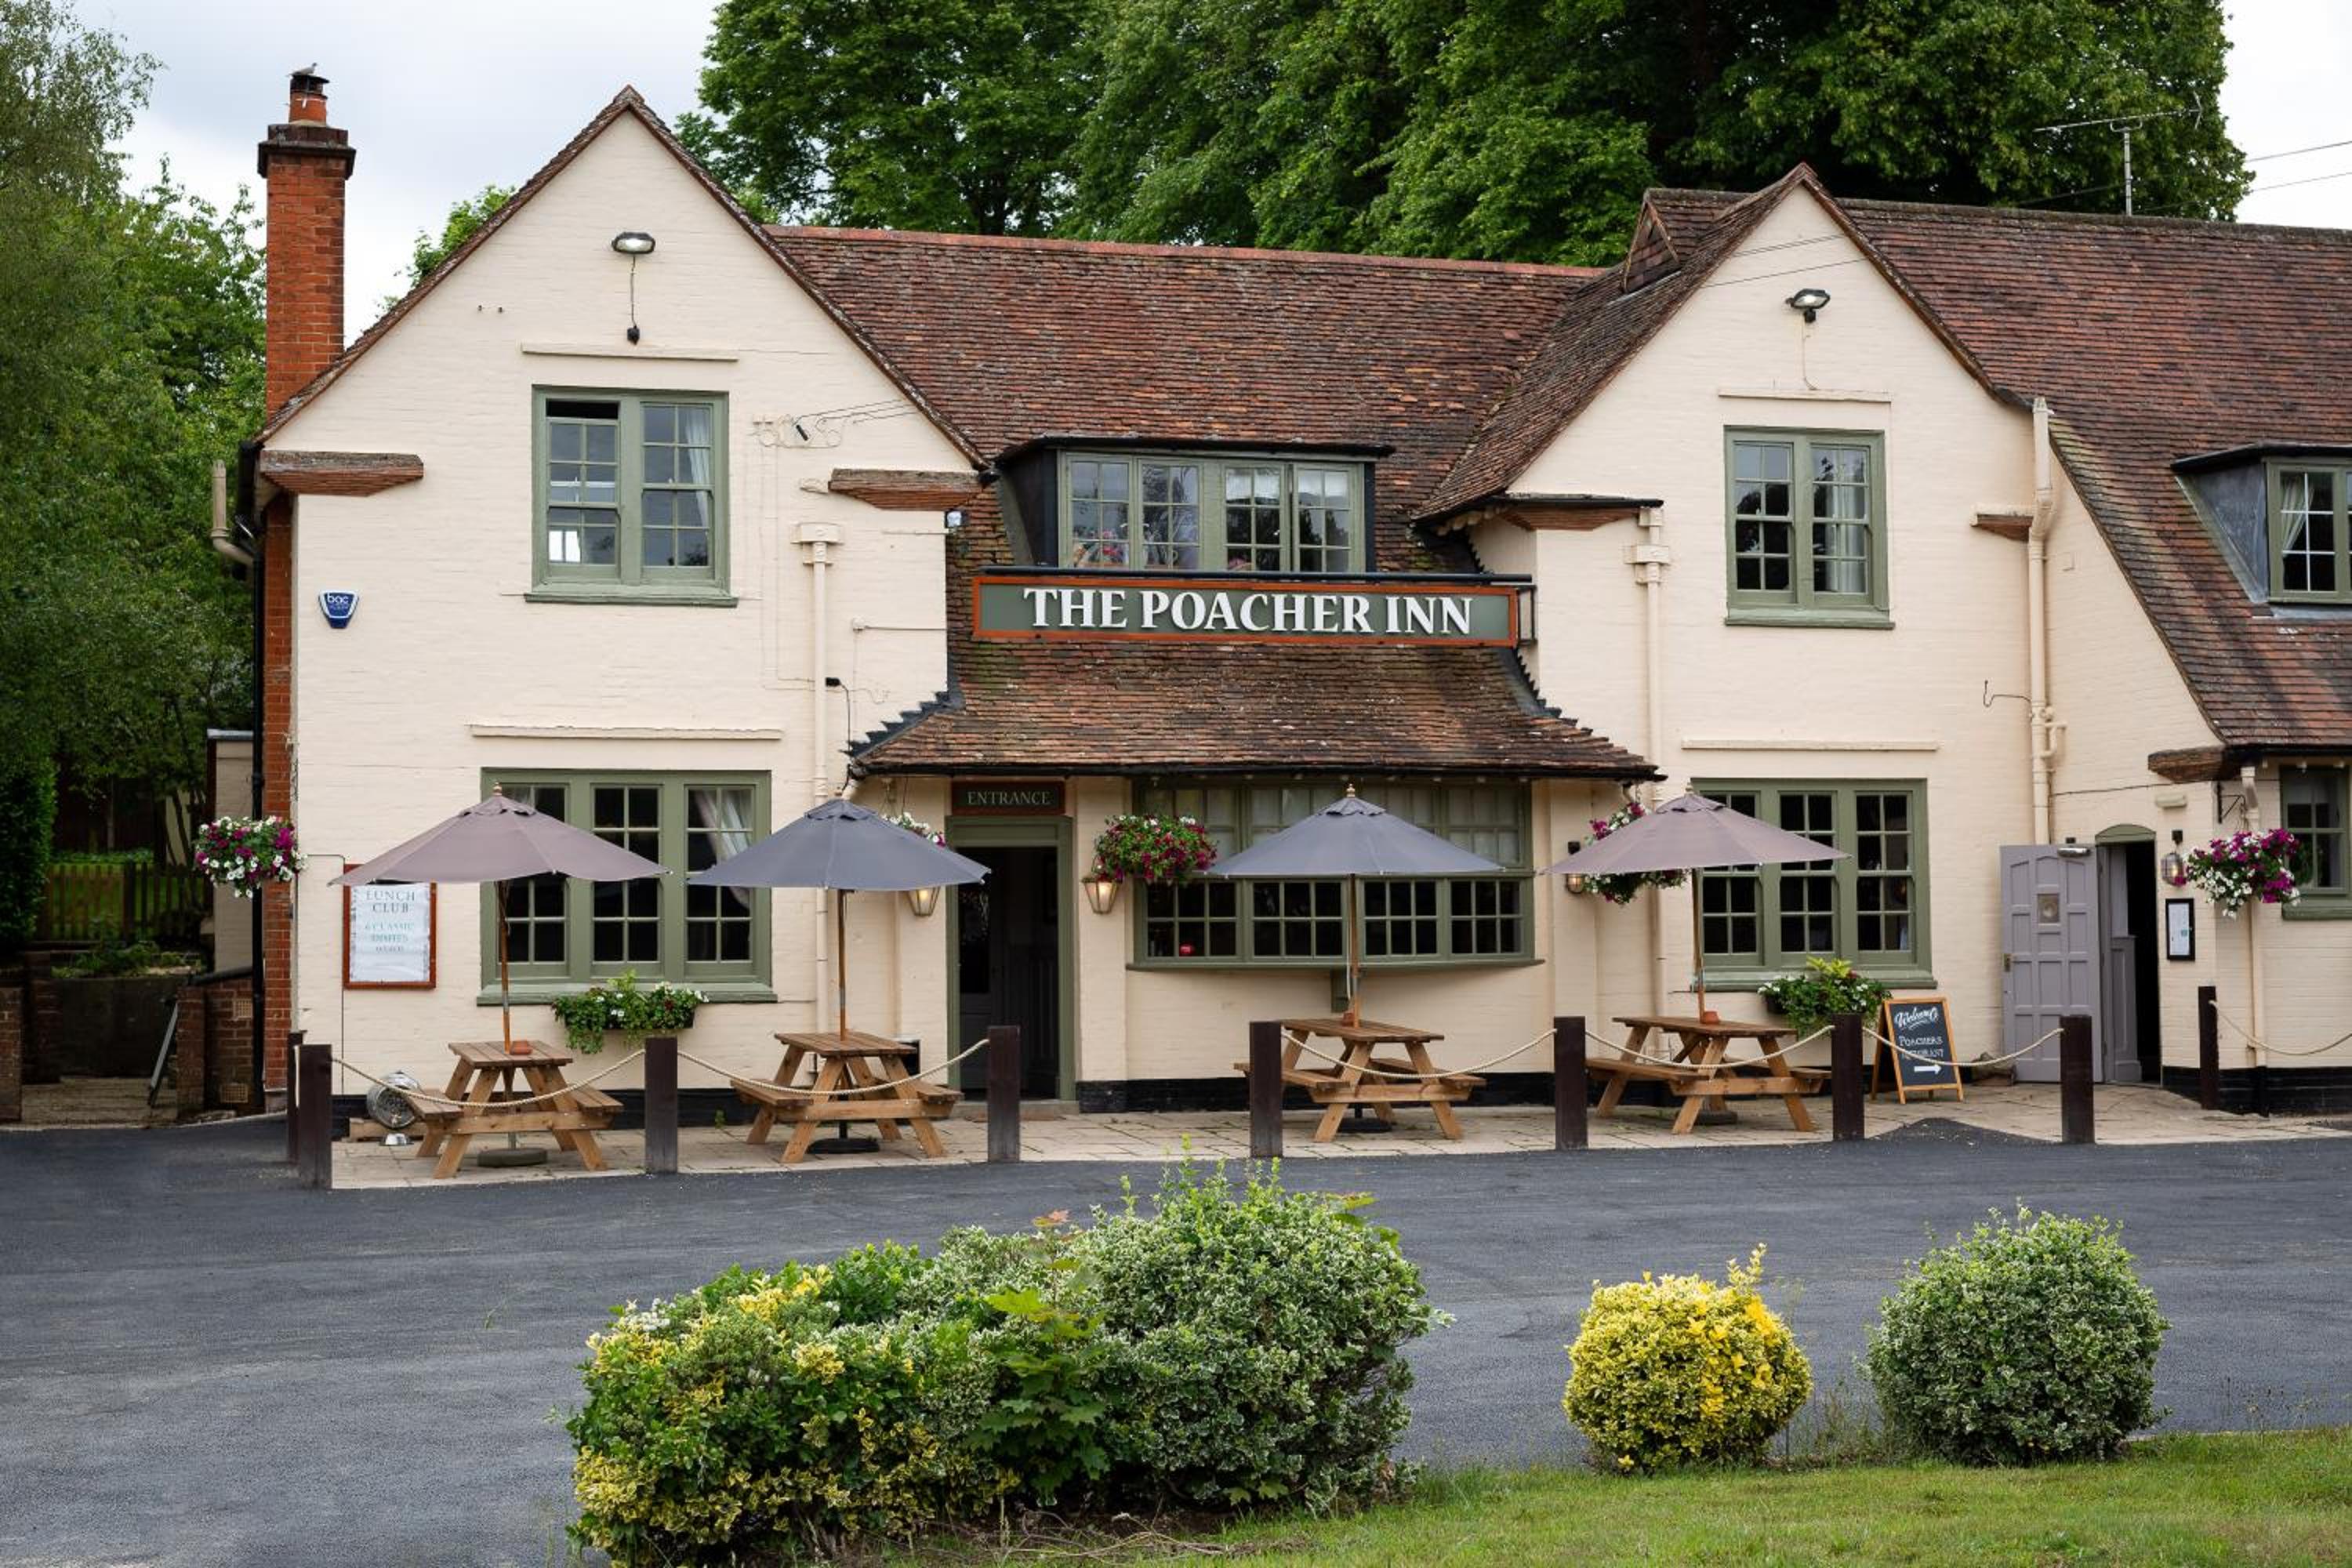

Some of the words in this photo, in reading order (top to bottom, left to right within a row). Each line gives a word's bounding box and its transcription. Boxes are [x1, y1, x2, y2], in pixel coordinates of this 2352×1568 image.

[1023, 588, 1127, 628] THE
[1139, 590, 1374, 633] POACHER
[1385, 595, 1473, 635] INN
[967, 790, 1051, 805] ENTRANCE
[372, 902, 408, 913] CLUB
